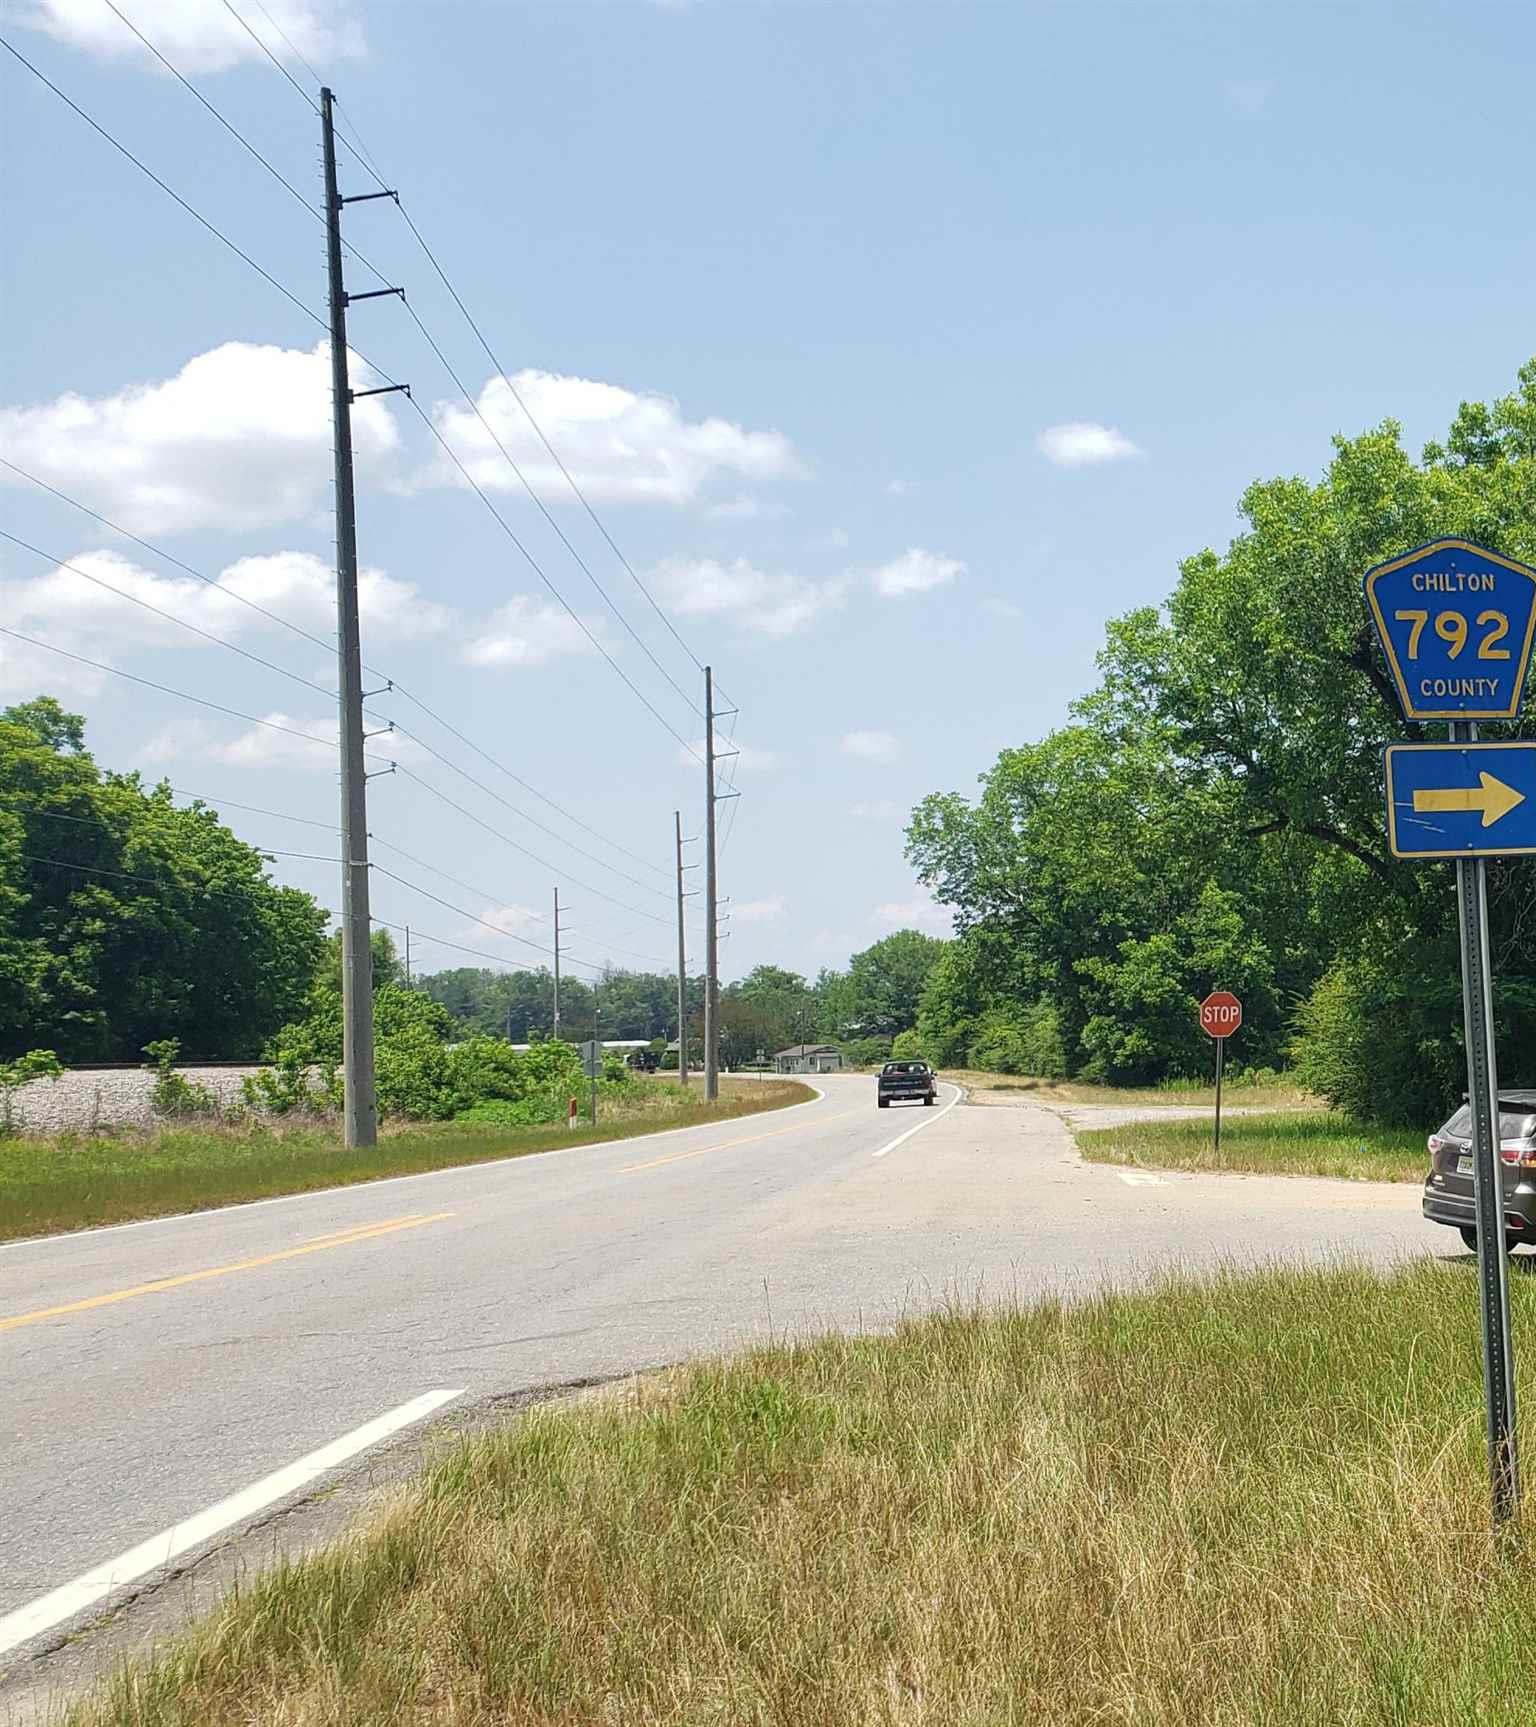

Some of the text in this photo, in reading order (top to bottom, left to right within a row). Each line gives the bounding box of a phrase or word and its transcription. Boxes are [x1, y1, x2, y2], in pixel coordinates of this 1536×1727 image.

[1412, 573, 1495, 592] CHILTON
[1395, 609, 1511, 660] 792
[1420, 678, 1499, 697] COUNTY
[1203, 1006, 1239, 1023] STOP
